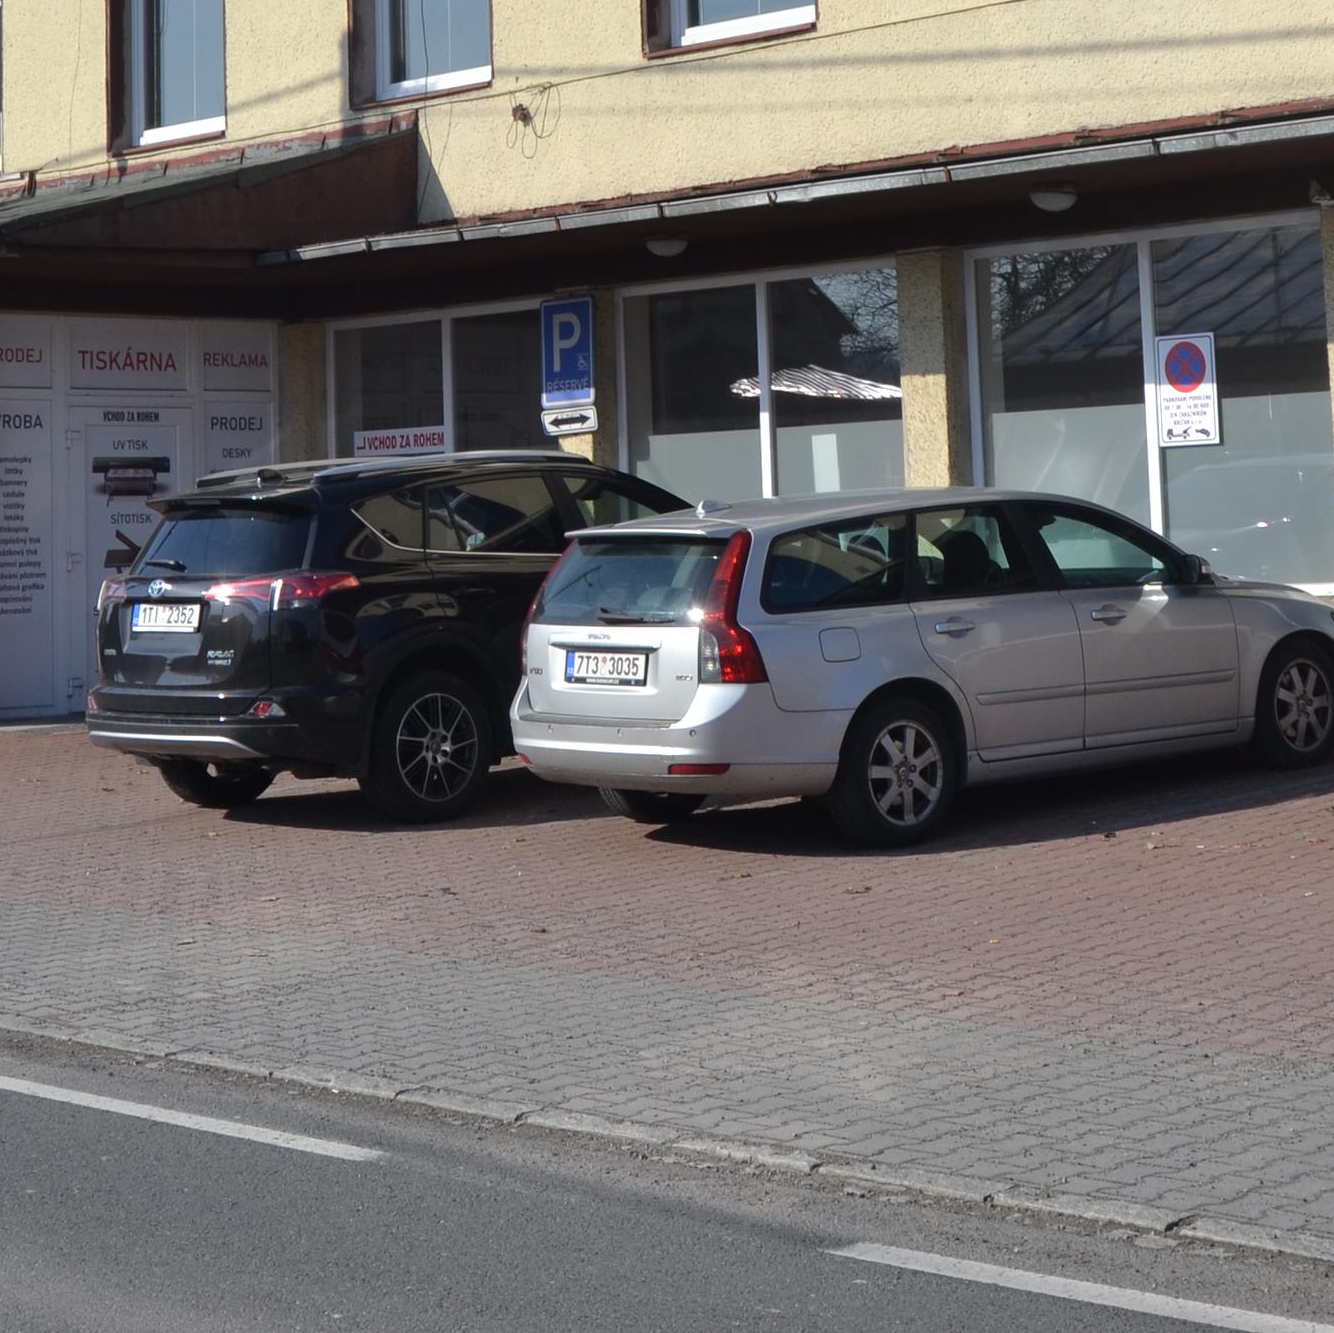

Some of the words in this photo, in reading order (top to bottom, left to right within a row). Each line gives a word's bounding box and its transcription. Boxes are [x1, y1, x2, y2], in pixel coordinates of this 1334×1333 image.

[553, 312, 581, 373] P
[78, 347, 177, 372] TISKÁRNA
[203, 352, 267, 367] REKLAMA
[103, 411, 126, 423] VCHOD
[126, 411, 136, 422] ZA
[137, 411, 159, 423] ROHEM
[210, 417, 263, 431] PRODEJ
[113, 439, 126, 450] UV
[126, 439, 148, 450] TISK
[367, 436, 397, 450] VCHOD
[399, 435, 411, 448] ZA
[413, 431, 444, 447] ROHEM
[222, 448, 252, 458] DESKY
[0, 479, 27, 487] bannery
[110, 512, 152, 524] SÍTOTISK
[29, 536, 41, 544] tisk
[26, 548, 38, 556] tisk
[167, 607, 194, 624] 2352
[576, 655, 599, 676] 7T3
[608, 656, 640, 676] 3035
